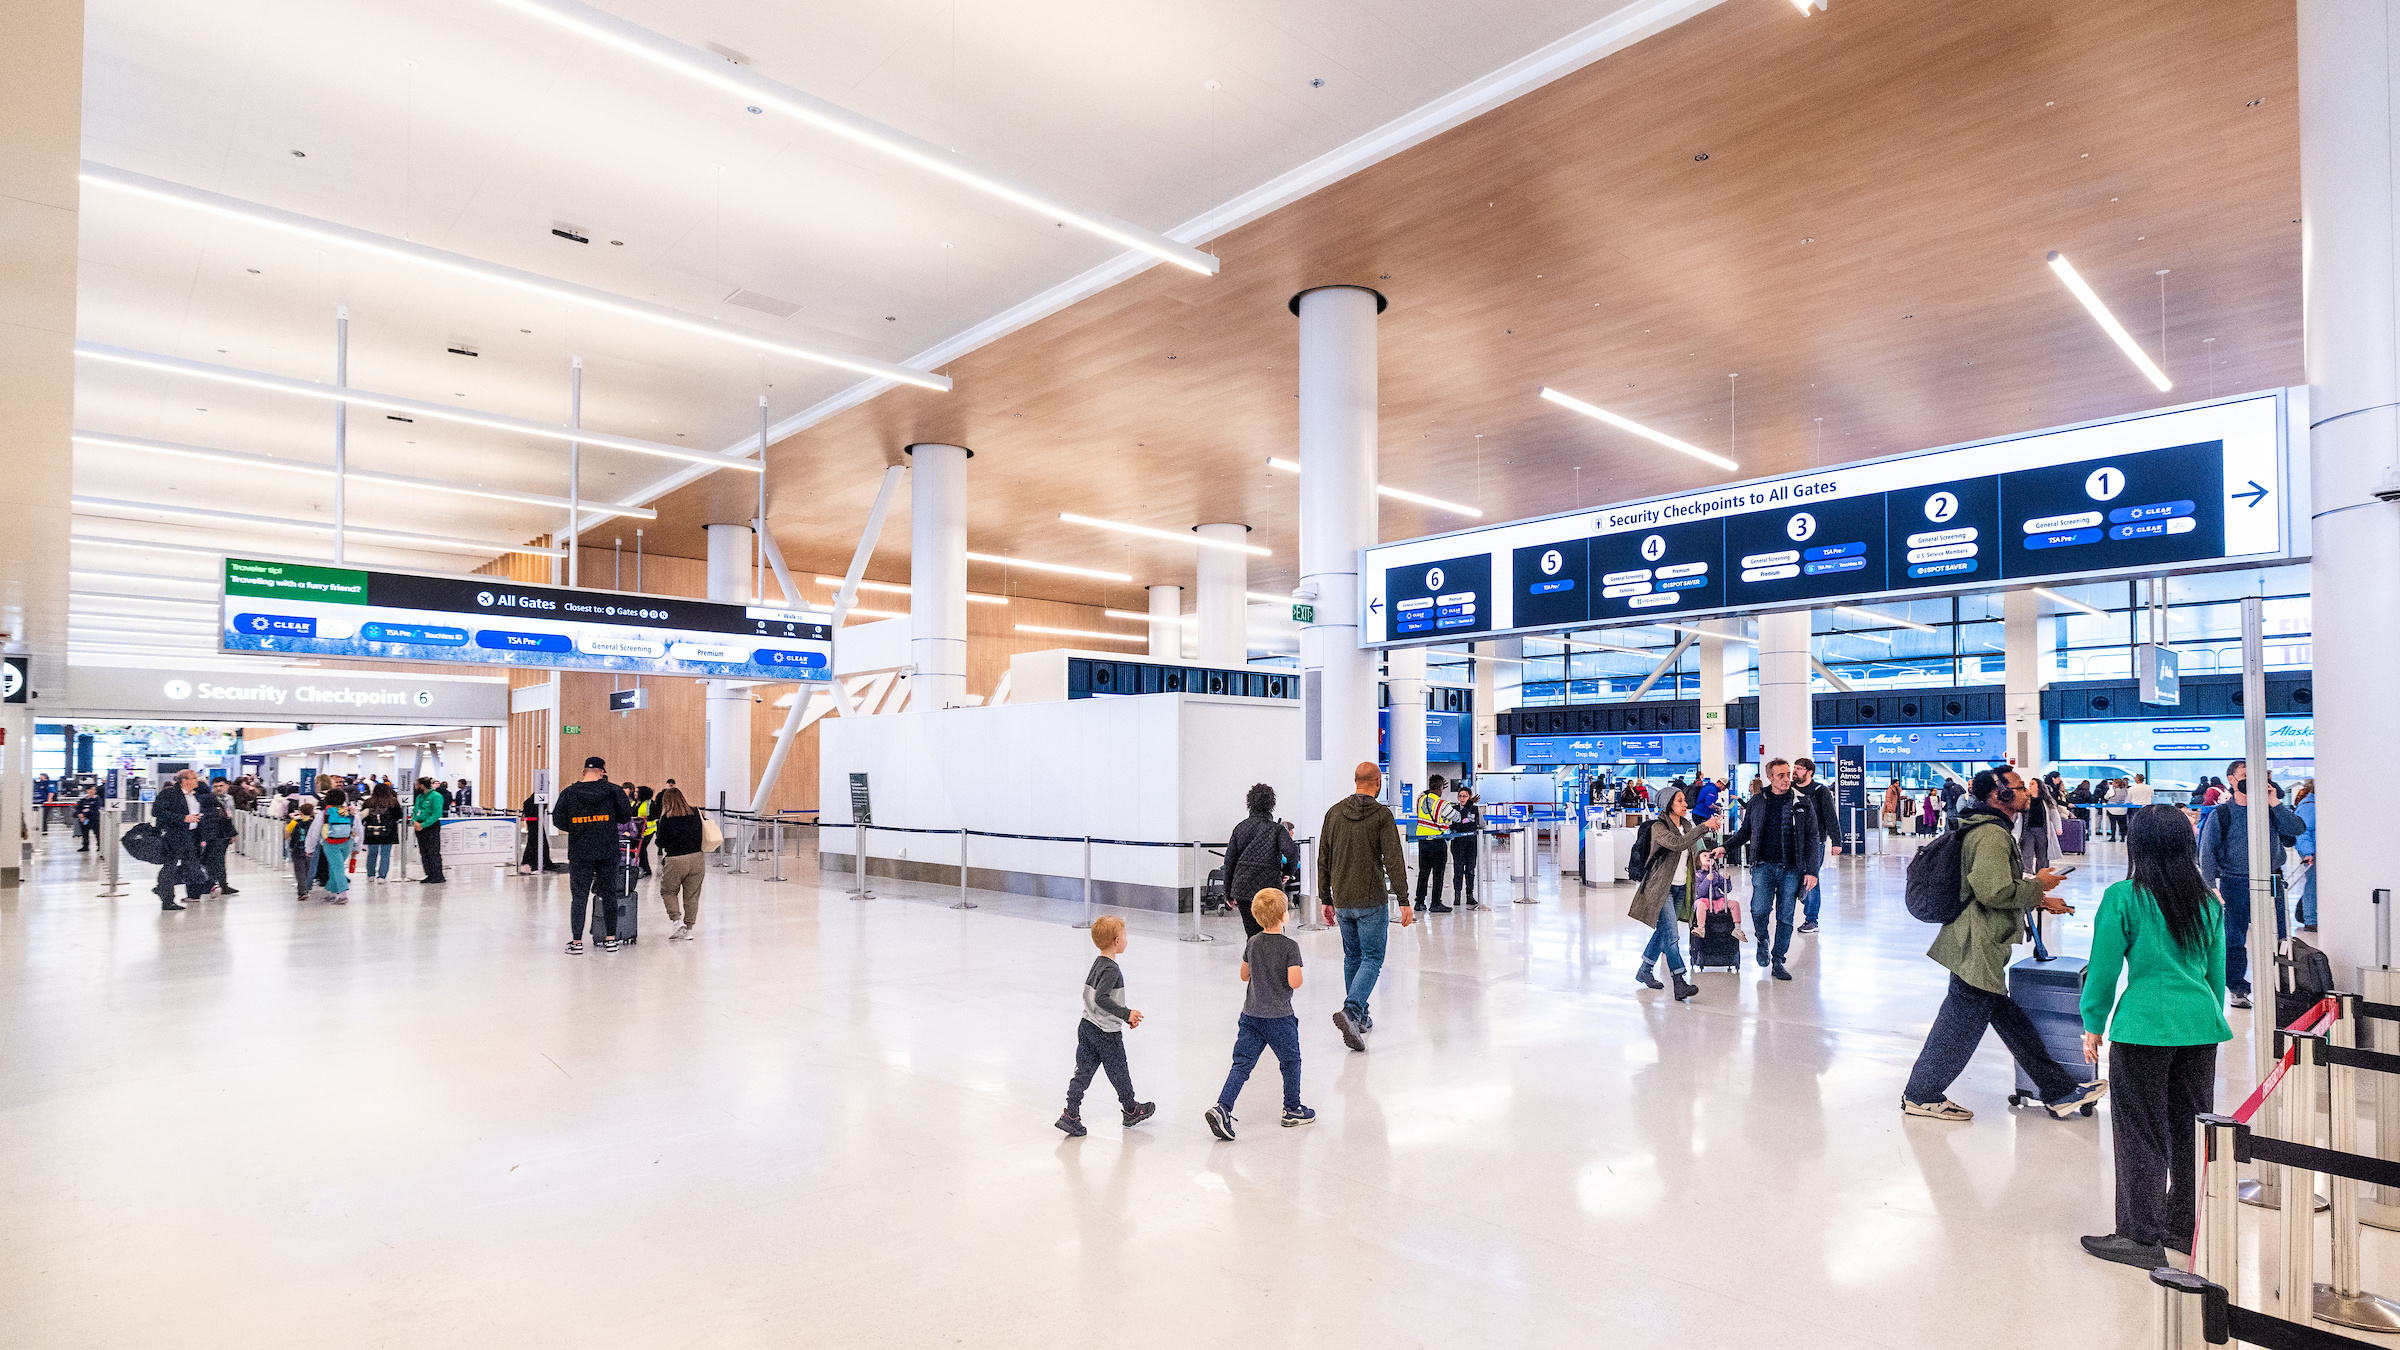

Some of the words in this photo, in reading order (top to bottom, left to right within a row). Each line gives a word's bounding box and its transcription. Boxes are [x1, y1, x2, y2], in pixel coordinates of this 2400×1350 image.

[2098, 473, 2108, 495] 1
[1609, 510, 1659, 527] Security
[1664, 496, 1745, 518] Checkpoints
[1749, 492, 1764, 505] to
[1769, 486, 1788, 502] All
[1794, 481, 1837, 497] Gates
[1935, 497, 1948, 518] 2
[1796, 518, 1807, 537] 3
[2035, 520, 2059, 529] General
[2060, 516, 2090, 526] Screening
[1918, 536, 1939, 544] General
[1940, 532, 1967, 542] Screening
[2048, 536, 2061, 544] TSA
[1648, 539, 1658, 556] 4
[1926, 549, 1945, 558] Service
[1945, 547, 1968, 555] Members
[1547, 554, 1556, 571] 5
[1750, 556, 1768, 564] General
[1768, 554, 1791, 563] Screening
[231, 564, 267, 573] Traveler
[268, 567, 282, 575] tip!
[1945, 562, 1968, 571] SAVER
[1610, 574, 1625, 582] General
[1625, 573, 1644, 581] Screening
[1760, 569, 1781, 577] Premium
[230, 575, 275, 587] Traveling
[275, 579, 297, 588] with
[306, 581, 329, 591] furry
[329, 583, 362, 593] friend?
[1431, 571, 1439, 587] 6
[1683, 578, 1701, 587] SAVER
[497, 594, 516, 607] All
[519, 596, 556, 610] Gates
[564, 602, 592, 613] Closest
[593, 605, 605, 614] to:
[617, 607, 638, 617] Gates
[1296, 605, 1311, 621] EXIT
[273, 621, 311, 630] CLEAR
[385, 629, 400, 637] TSA
[424, 631, 455, 640] Touchless
[455, 633, 463, 641] ID
[507, 636, 523, 645] TSA
[592, 642, 618, 651] General
[619, 643, 652, 654] Screening
[697, 649, 724, 658] Premium
[198, 681, 288, 706] Security
[294, 685, 407, 708] Checkpoint
[418, 691, 429, 706] 6
[1869, 734, 1903, 744] Alaska
[1588, 751, 1599, 759] Bag
[1879, 746, 1896, 755] Drop
[1897, 746, 1911, 755] Bag
[1840, 759, 1854, 767] First
[571, 814, 610, 824] OUTLAWS
